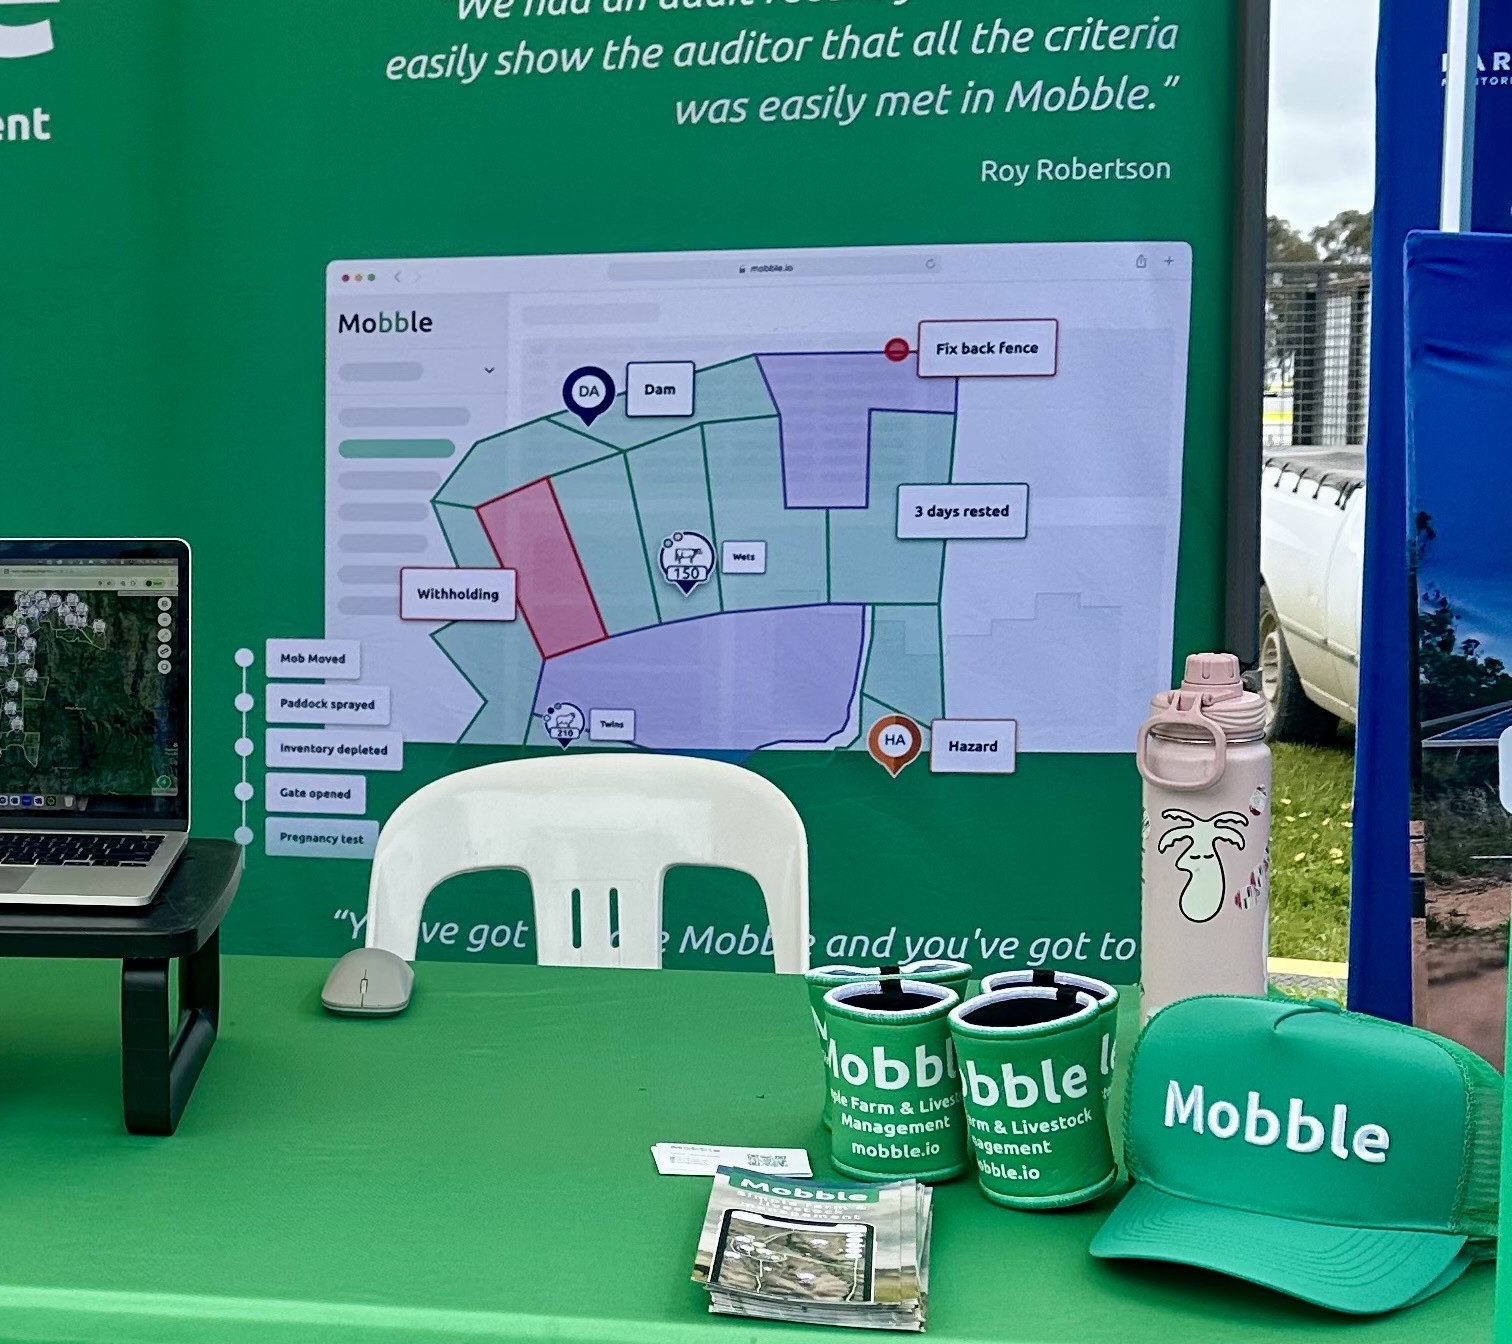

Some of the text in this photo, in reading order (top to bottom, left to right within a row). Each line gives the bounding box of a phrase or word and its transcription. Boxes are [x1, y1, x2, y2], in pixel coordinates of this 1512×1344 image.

[385, 15, 1179, 85] easily show the auditor that all the criteria
[675, 97, 750, 125] was
[758, 83, 868, 126] easily
[875, 83, 953, 117] met
[960, 80, 995, 114] in
[981, 156, 1171, 187] Roy Robertson
[337, 309, 435, 336] Mobble
[936, 340, 1039, 355] Fix back fence
[578, 384, 600, 398] DA
[644, 384, 676, 397] Dam
[914, 504, 1010, 521] 3 days rested
[673, 567, 700, 580] 150
[416, 587, 500, 603] Withholding
[280, 653, 346, 664] Mob Moved
[280, 698, 375, 712] Paddock sprayed
[557, 729, 574, 737] 210
[883, 733, 906, 747] HA
[280, 743, 388, 756] Inventory depleted
[948, 739, 999, 753] Hazard
[280, 787, 352, 802] Gate opened
[280, 831, 365, 846] Pregnancy test
[466, 919, 528, 952] got
[824, 926, 897, 959] and
[1025, 930, 1091, 966] got
[1099, 930, 1138, 961] to
[850, 1096, 895, 1115] Farm
[899, 1101, 915, 1115] &
[841, 1112, 951, 1138] Management
[993, 1119, 1008, 1135] &
[1011, 1107, 1093, 1135] Livestock
[1164, 1079, 1390, 1163] Mobble
[851, 1141, 941, 1160] mobble.io
[740, 1178, 869, 1202] Mobble
